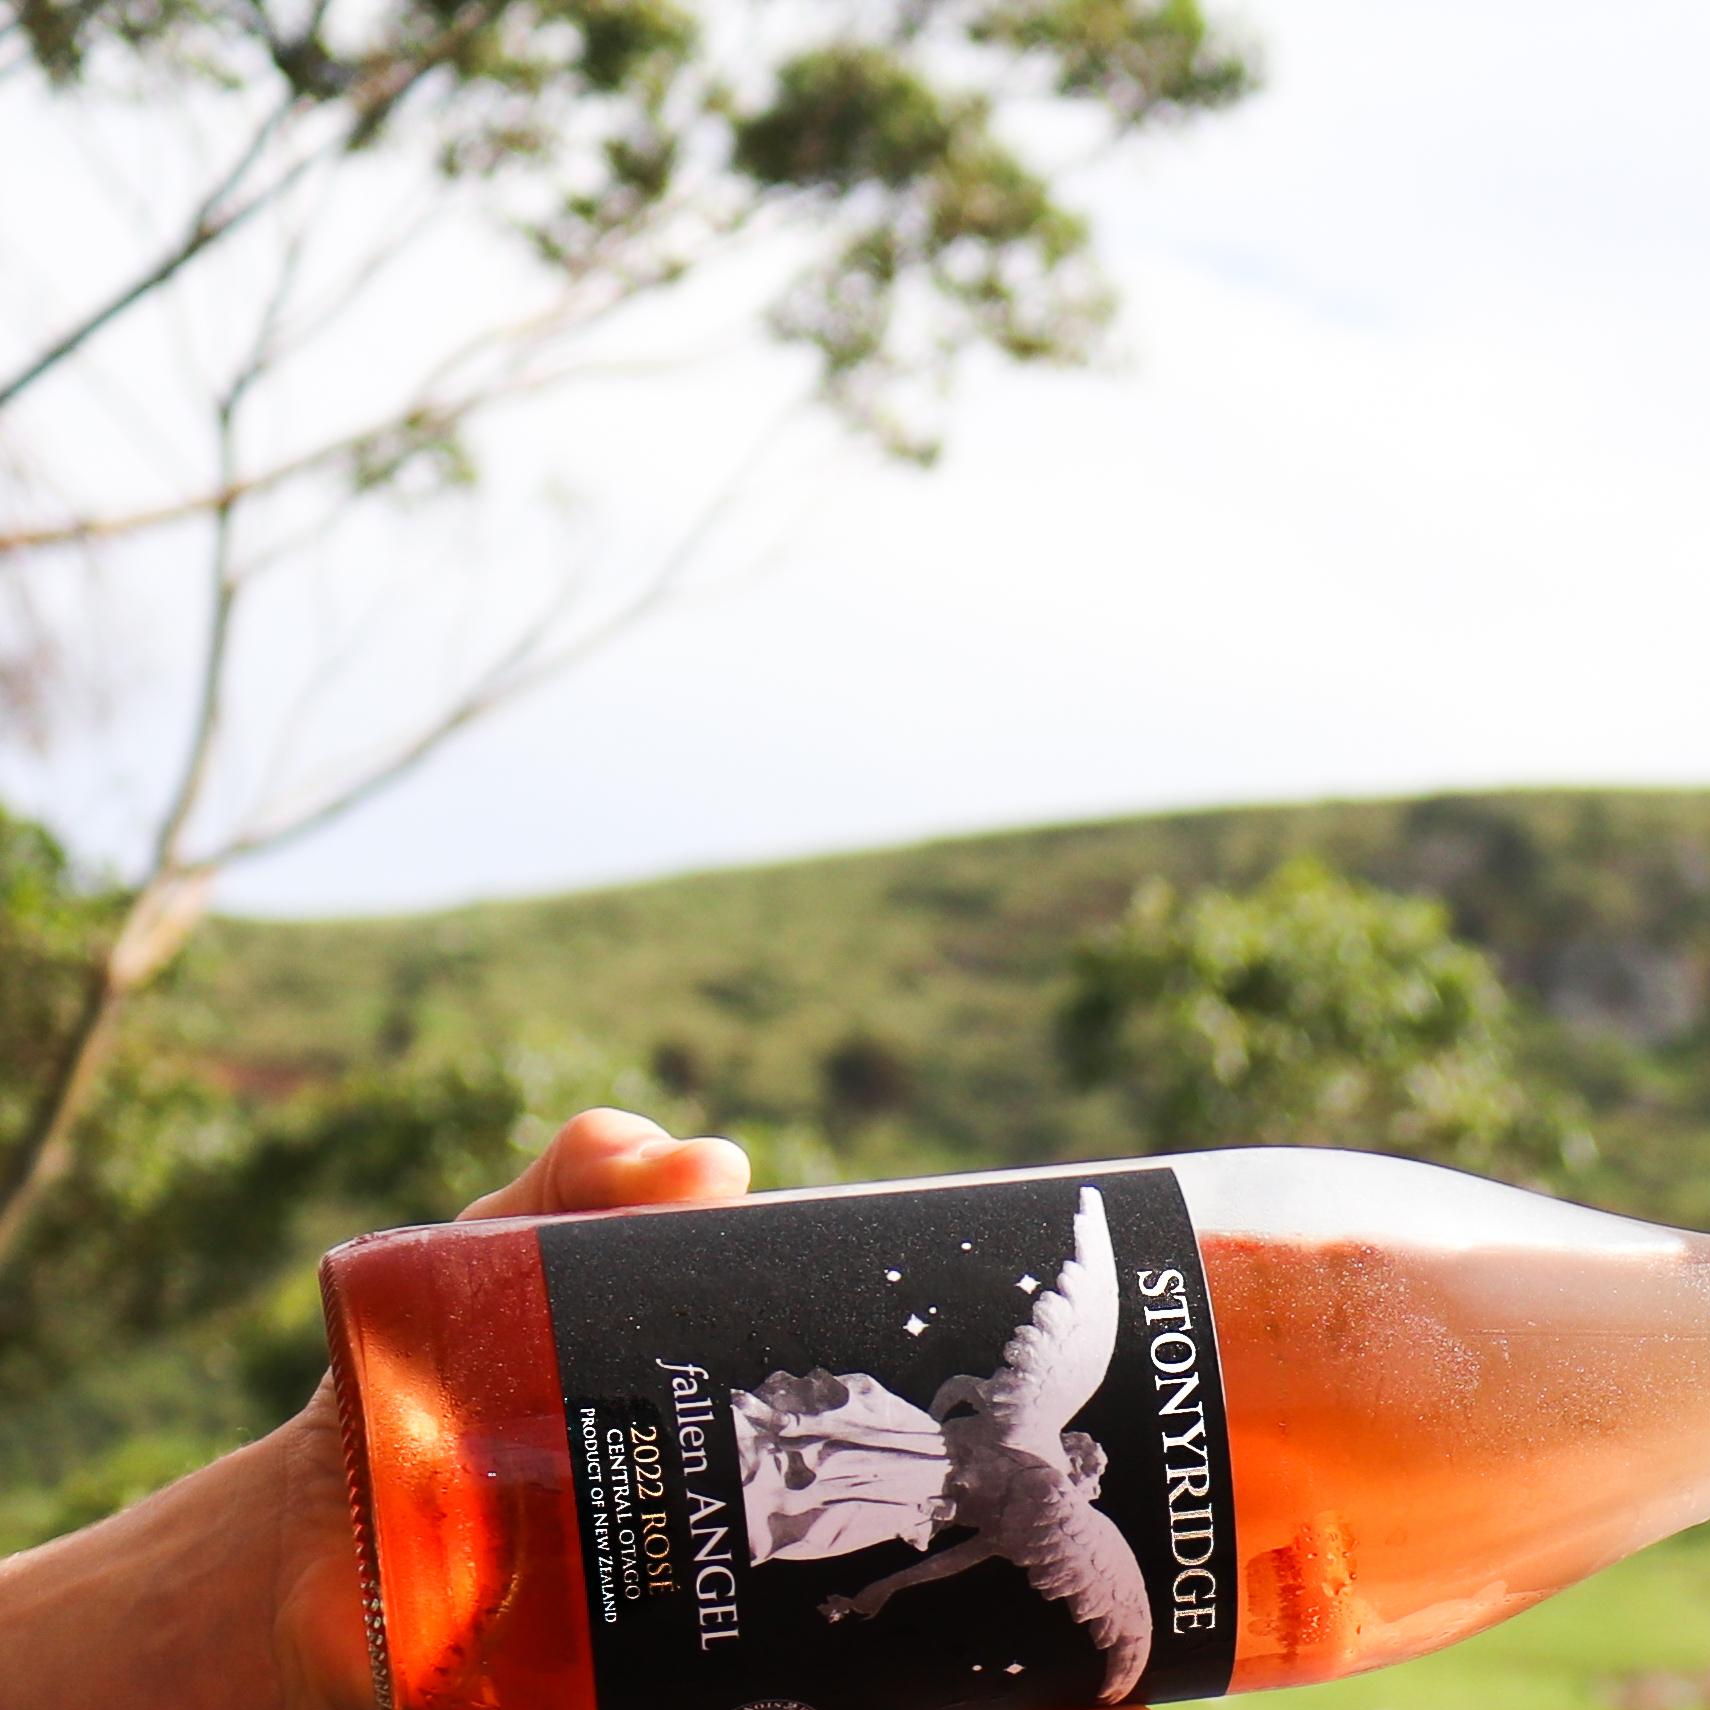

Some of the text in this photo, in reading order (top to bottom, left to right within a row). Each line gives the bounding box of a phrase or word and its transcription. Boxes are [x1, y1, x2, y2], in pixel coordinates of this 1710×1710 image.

[580, 1407, 617, 1624] PRODUCT OF NEW ZEALAND
[606, 1428, 641, 1600] CENTRAL OTAGO
[630, 1426, 681, 1595] 2022 ROSÉ
[655, 1358, 740, 1650] fallen ANGEL
[1137, 1269, 1217, 1634] STONYRIDGE
